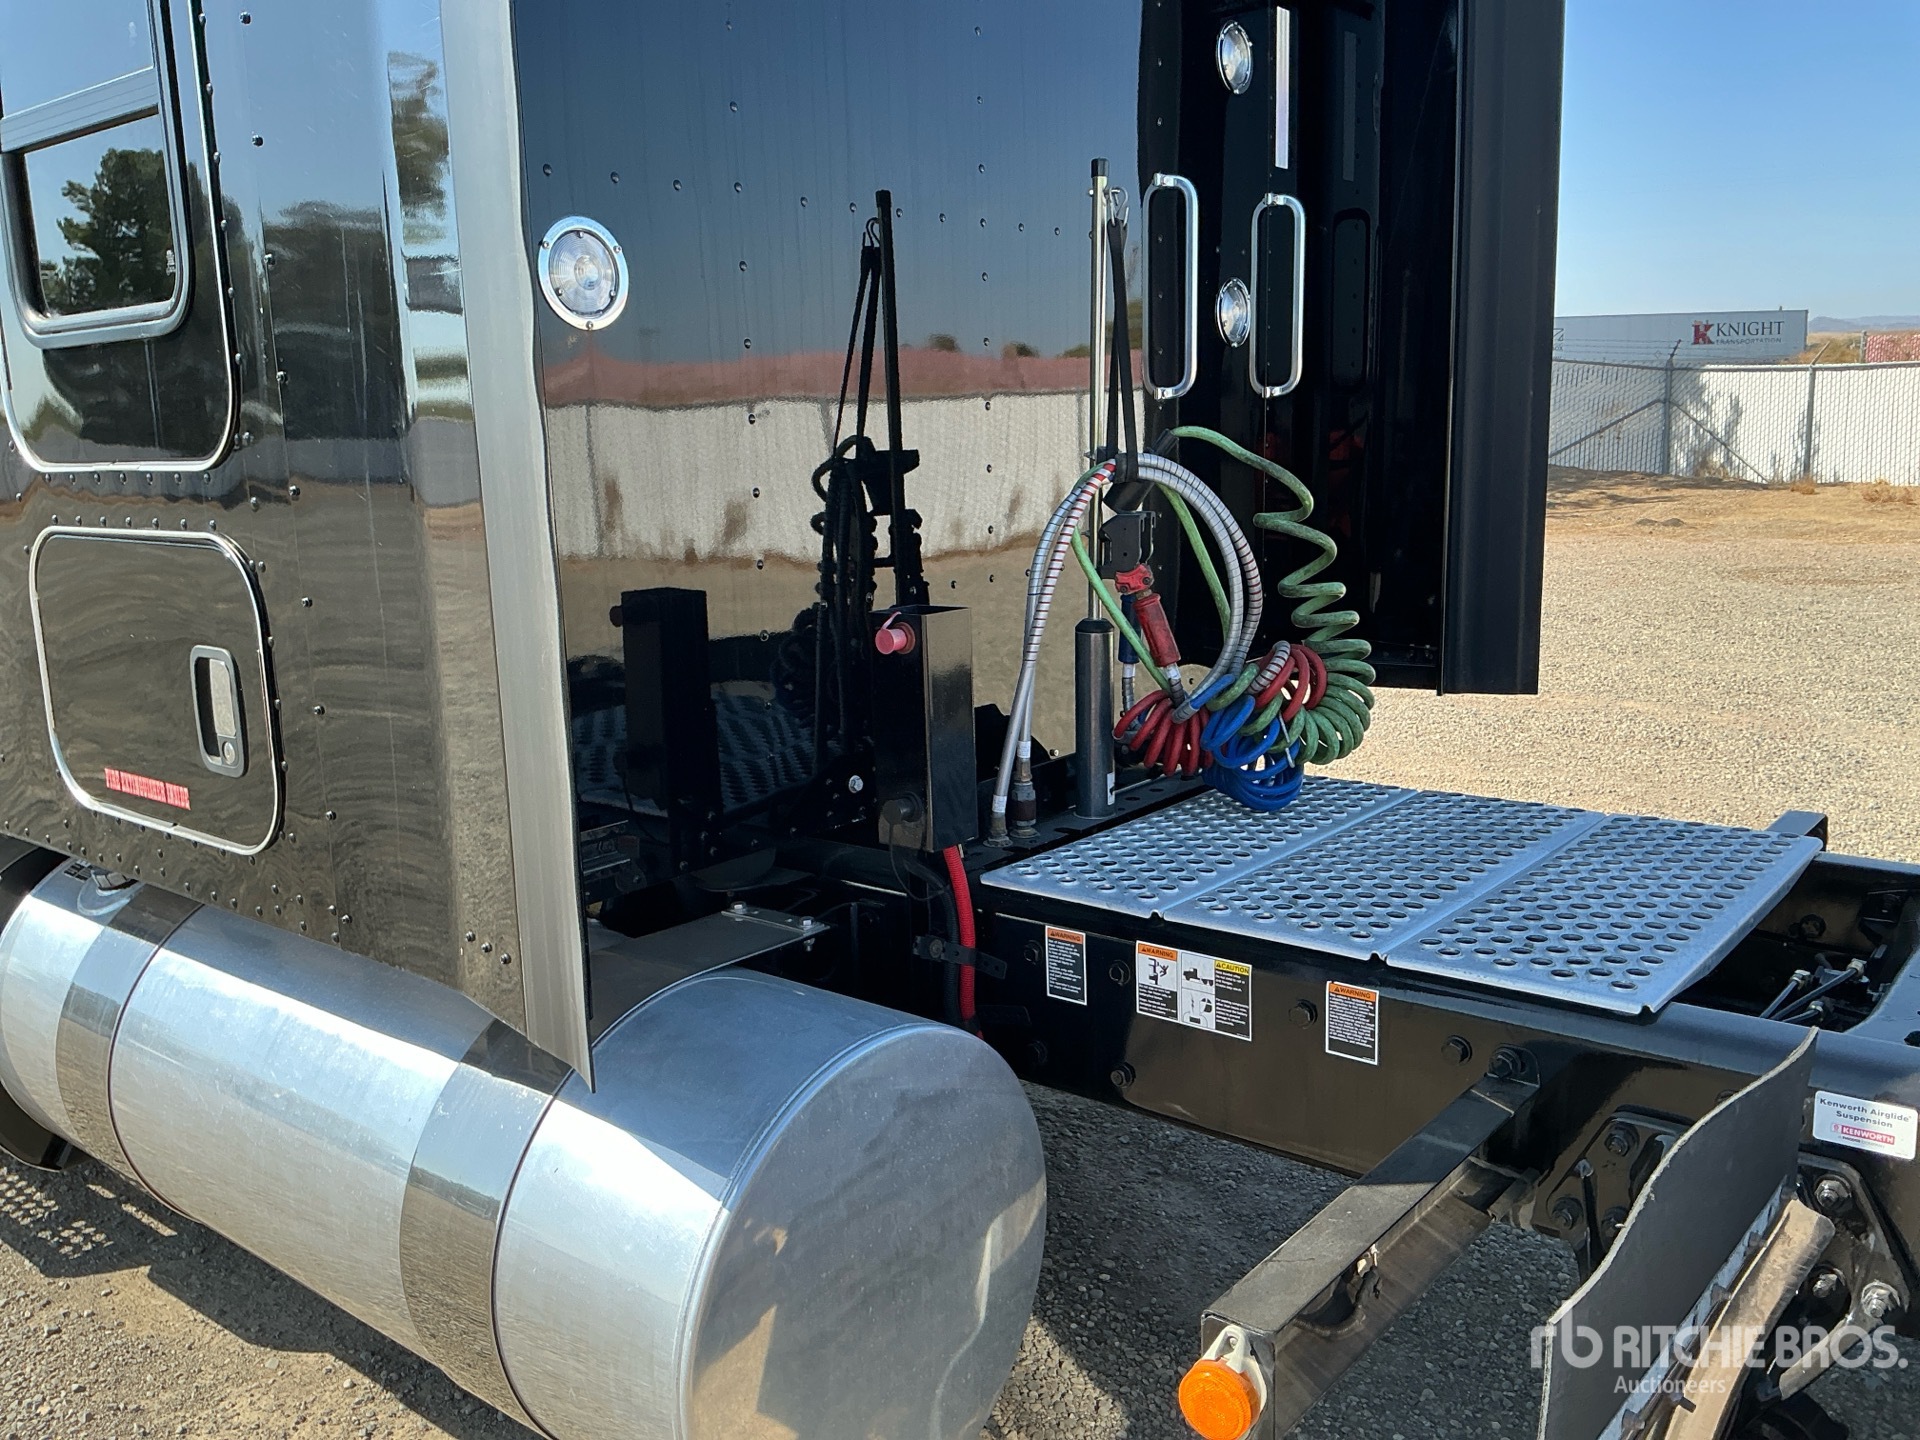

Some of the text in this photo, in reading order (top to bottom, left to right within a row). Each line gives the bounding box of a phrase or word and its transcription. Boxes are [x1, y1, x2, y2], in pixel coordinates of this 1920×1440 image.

[1716, 321, 1785, 337] KNIGHT
[1715, 337, 1782, 345] TRANSPORTATION
[1054, 931, 1081, 942] WARNING
[1146, 948, 1174, 958] WARNING
[1220, 962, 1249, 974] CAUTION
[1339, 987, 1371, 999] WARNING
[1819, 1098, 1868, 1114] Kenworth
[1836, 1110, 1893, 1128] Suspension
[1842, 1127, 1894, 1144] KENWORTH
